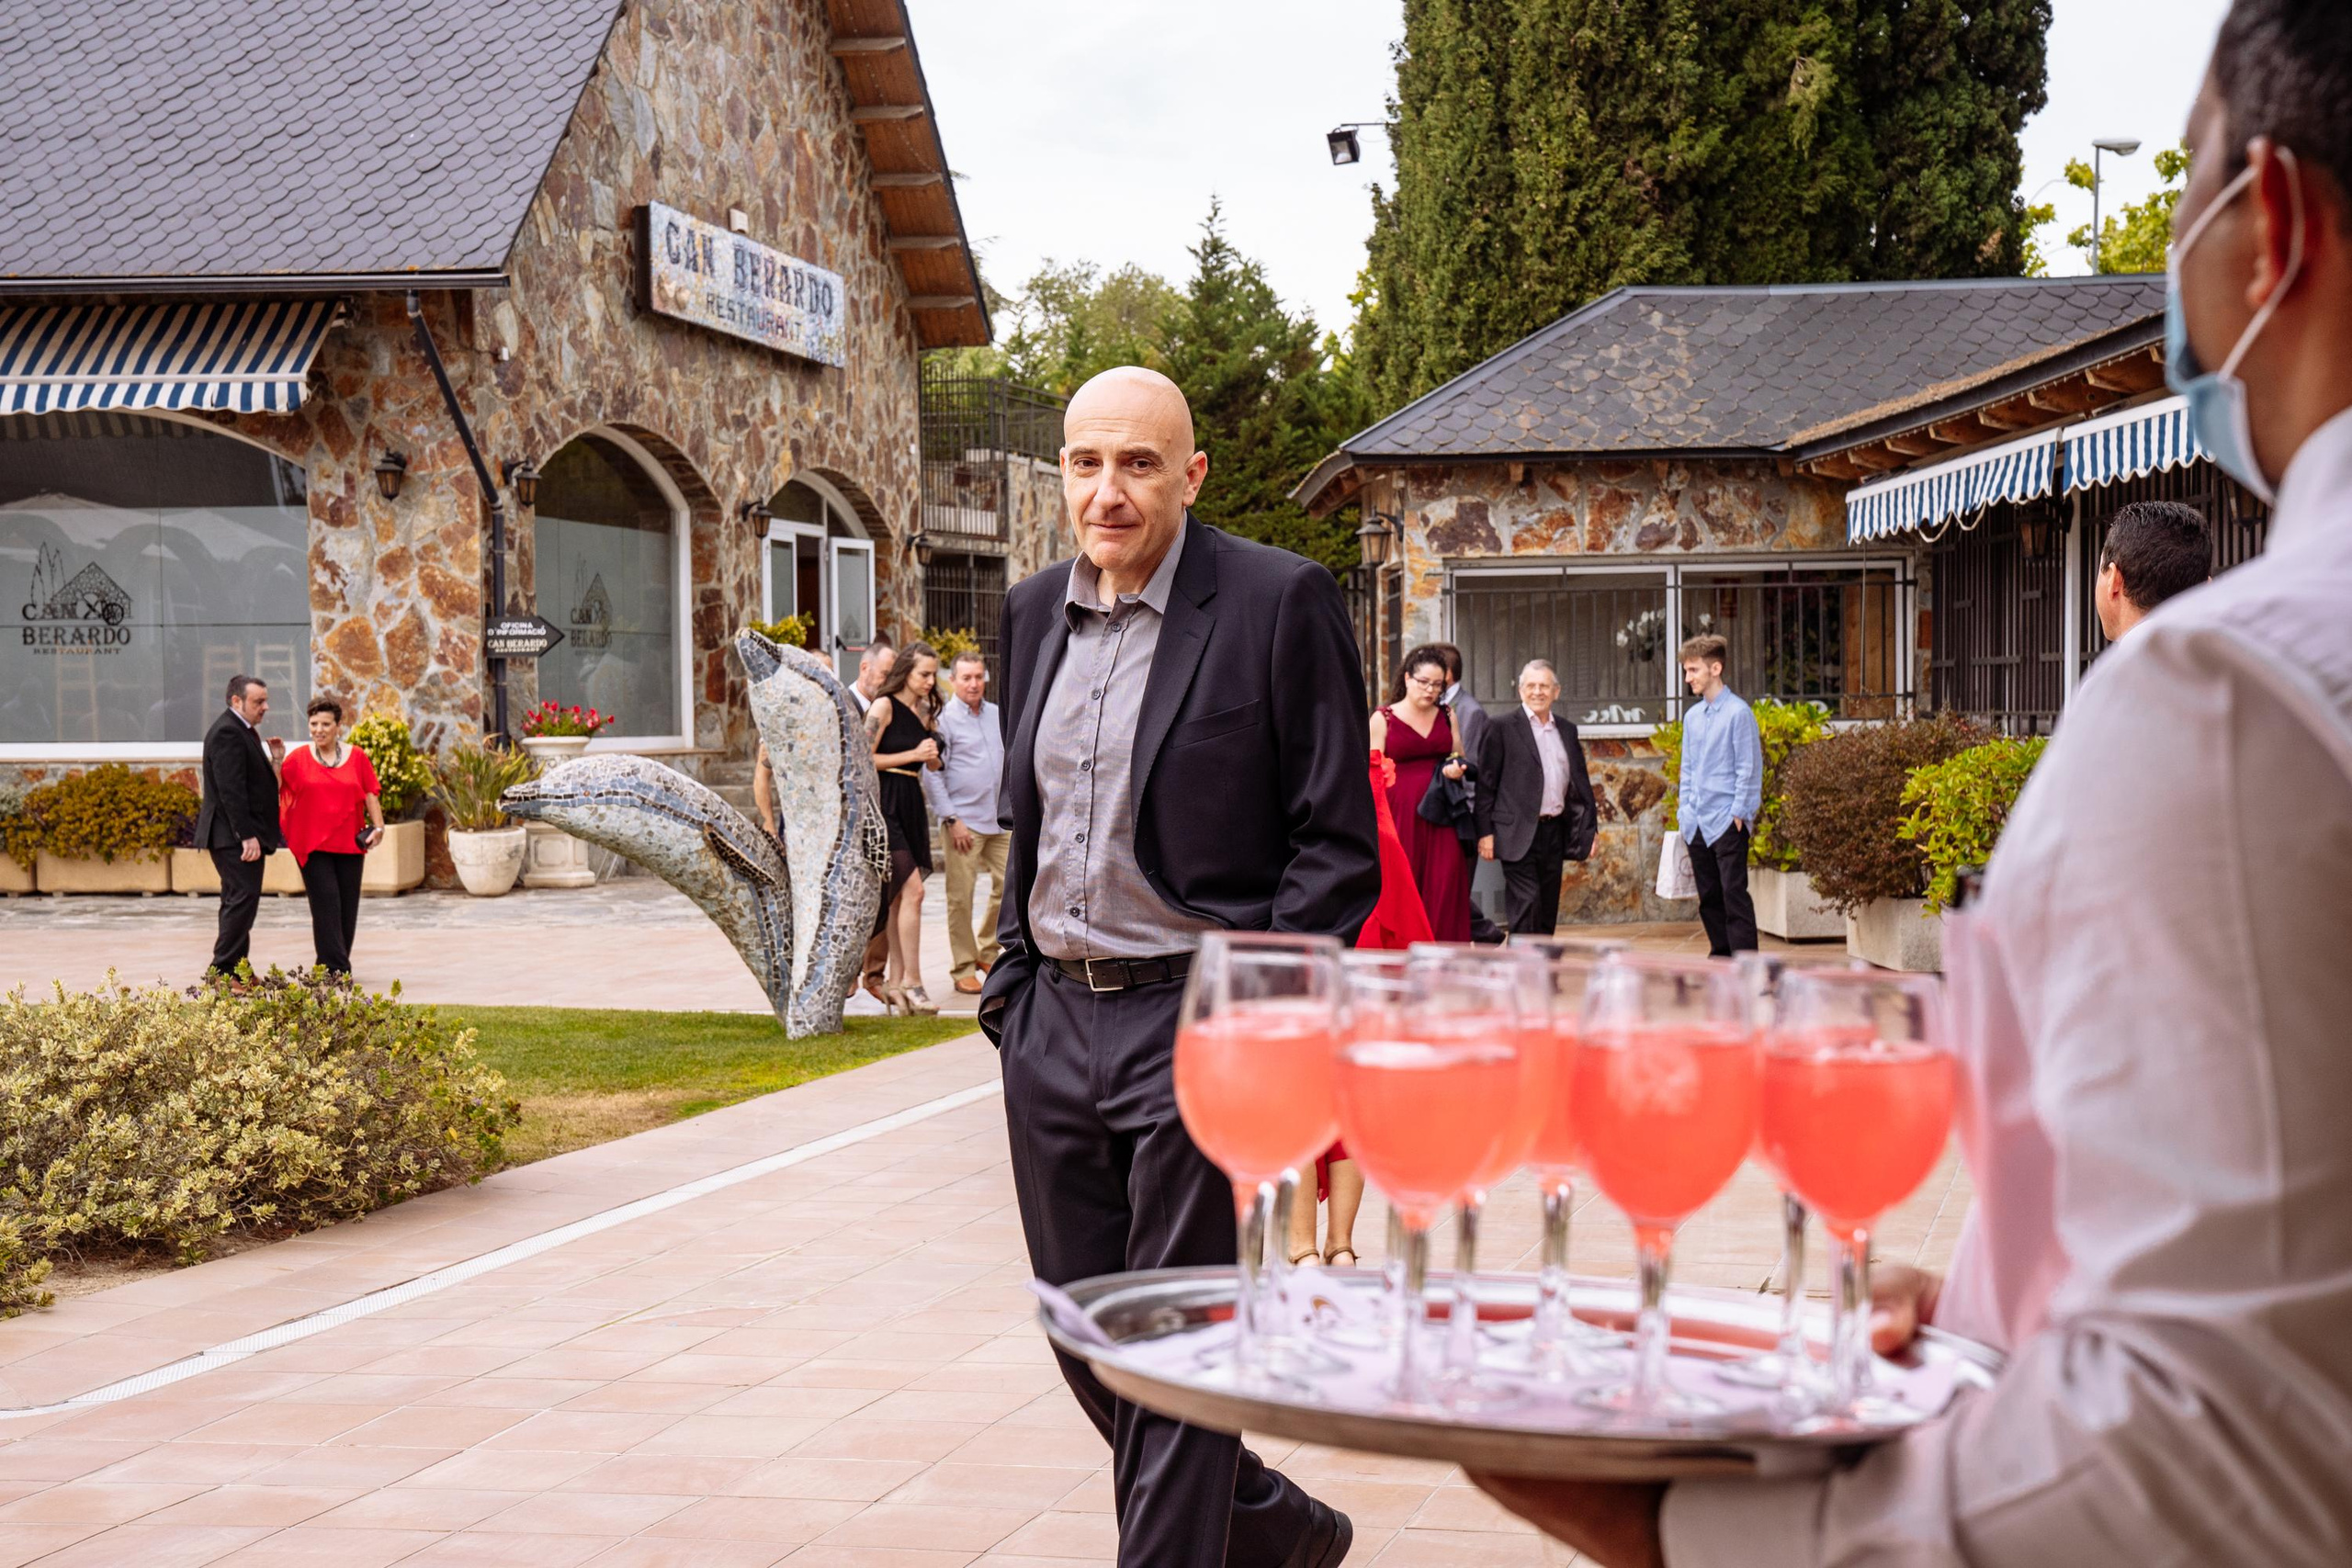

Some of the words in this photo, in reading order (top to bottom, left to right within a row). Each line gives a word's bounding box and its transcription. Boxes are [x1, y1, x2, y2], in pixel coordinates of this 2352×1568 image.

[666, 221, 715, 277] CAN
[733, 243, 833, 318] BERARDO
[22, 604, 77, 621] CAN
[501, 622, 534, 630] OFICINA
[22, 626, 130, 646] BERARDO
[487, 639, 505, 649] CAN
[506, 638, 548, 649] BERARDO
